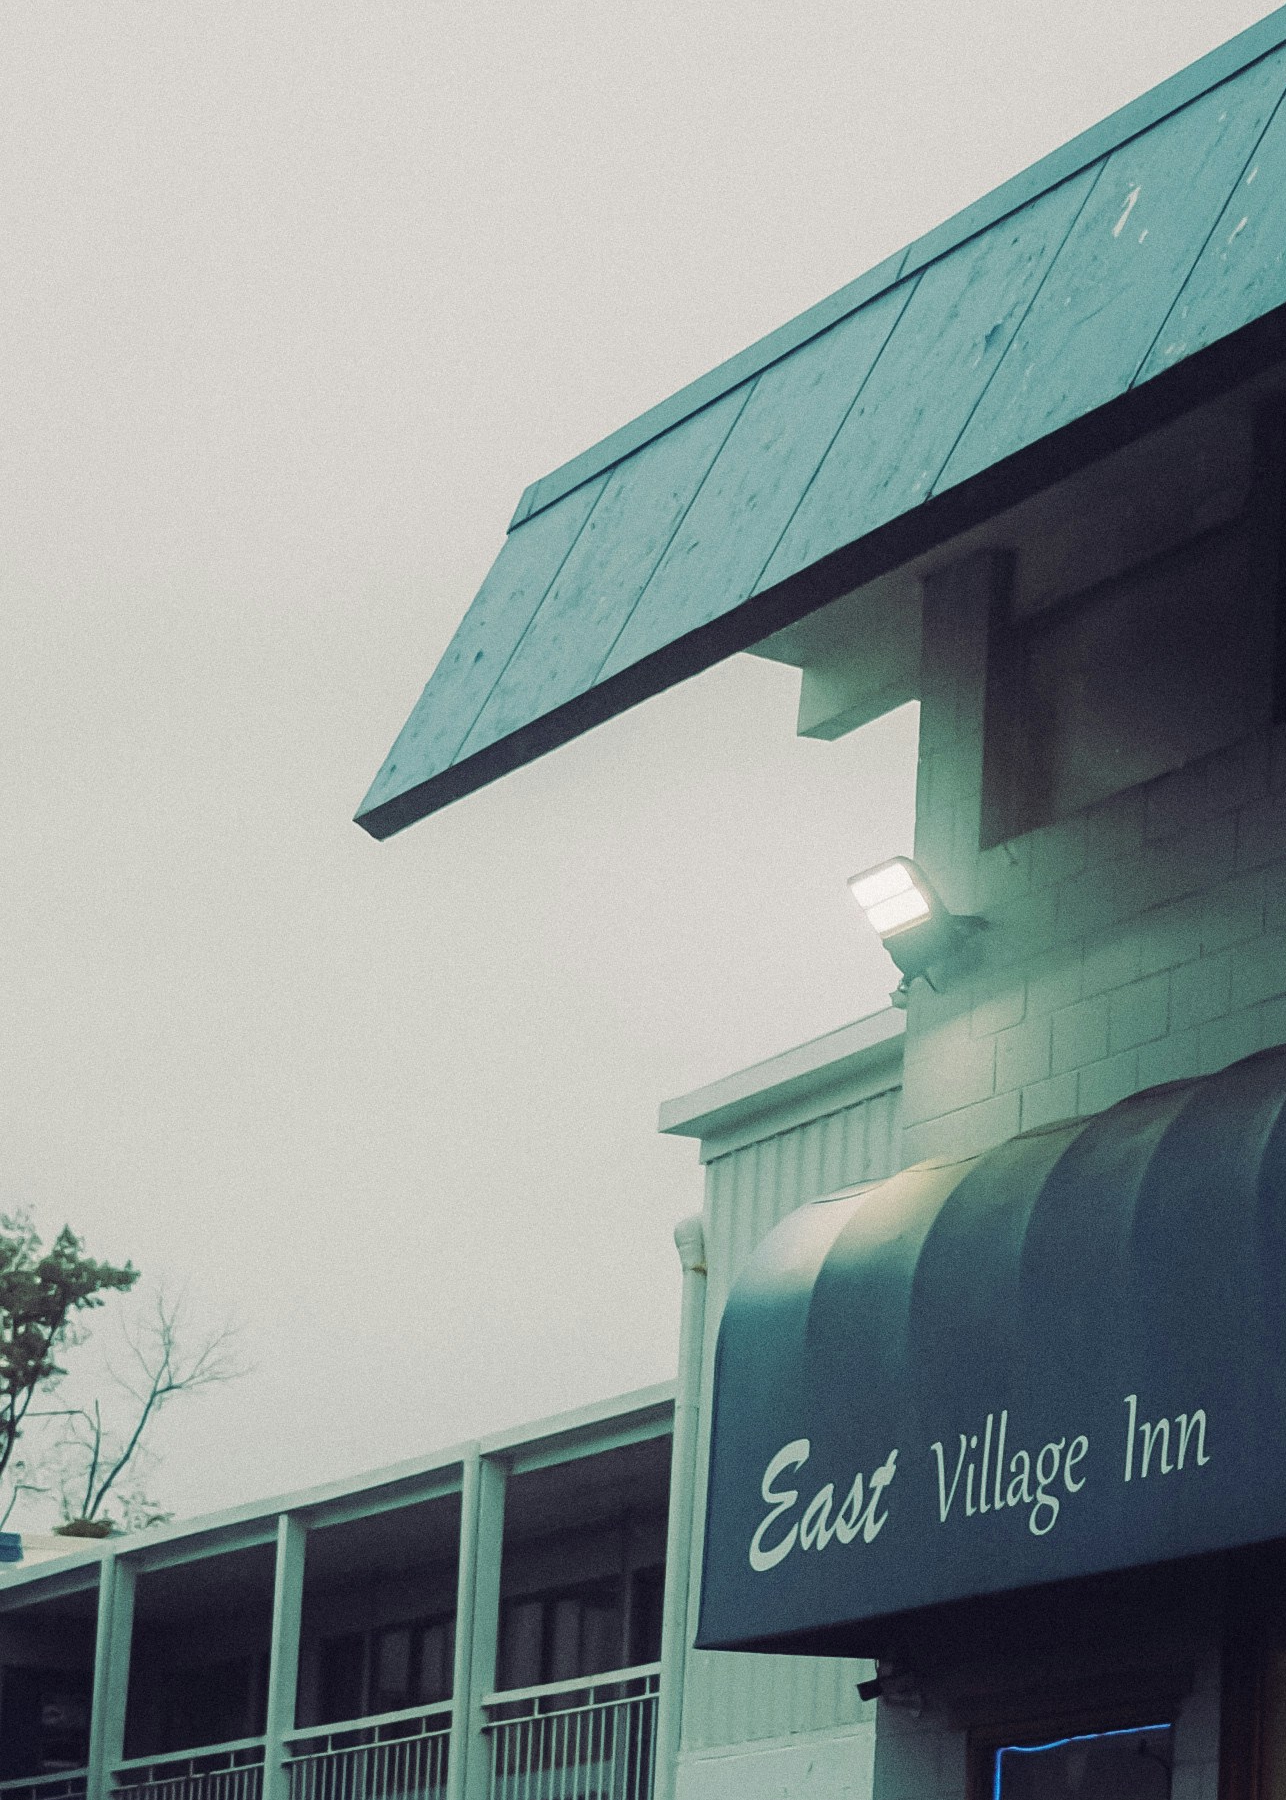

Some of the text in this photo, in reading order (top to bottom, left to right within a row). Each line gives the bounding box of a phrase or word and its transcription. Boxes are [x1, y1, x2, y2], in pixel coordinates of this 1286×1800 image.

[748, 1394, 1211, 1572] East Village Inn
